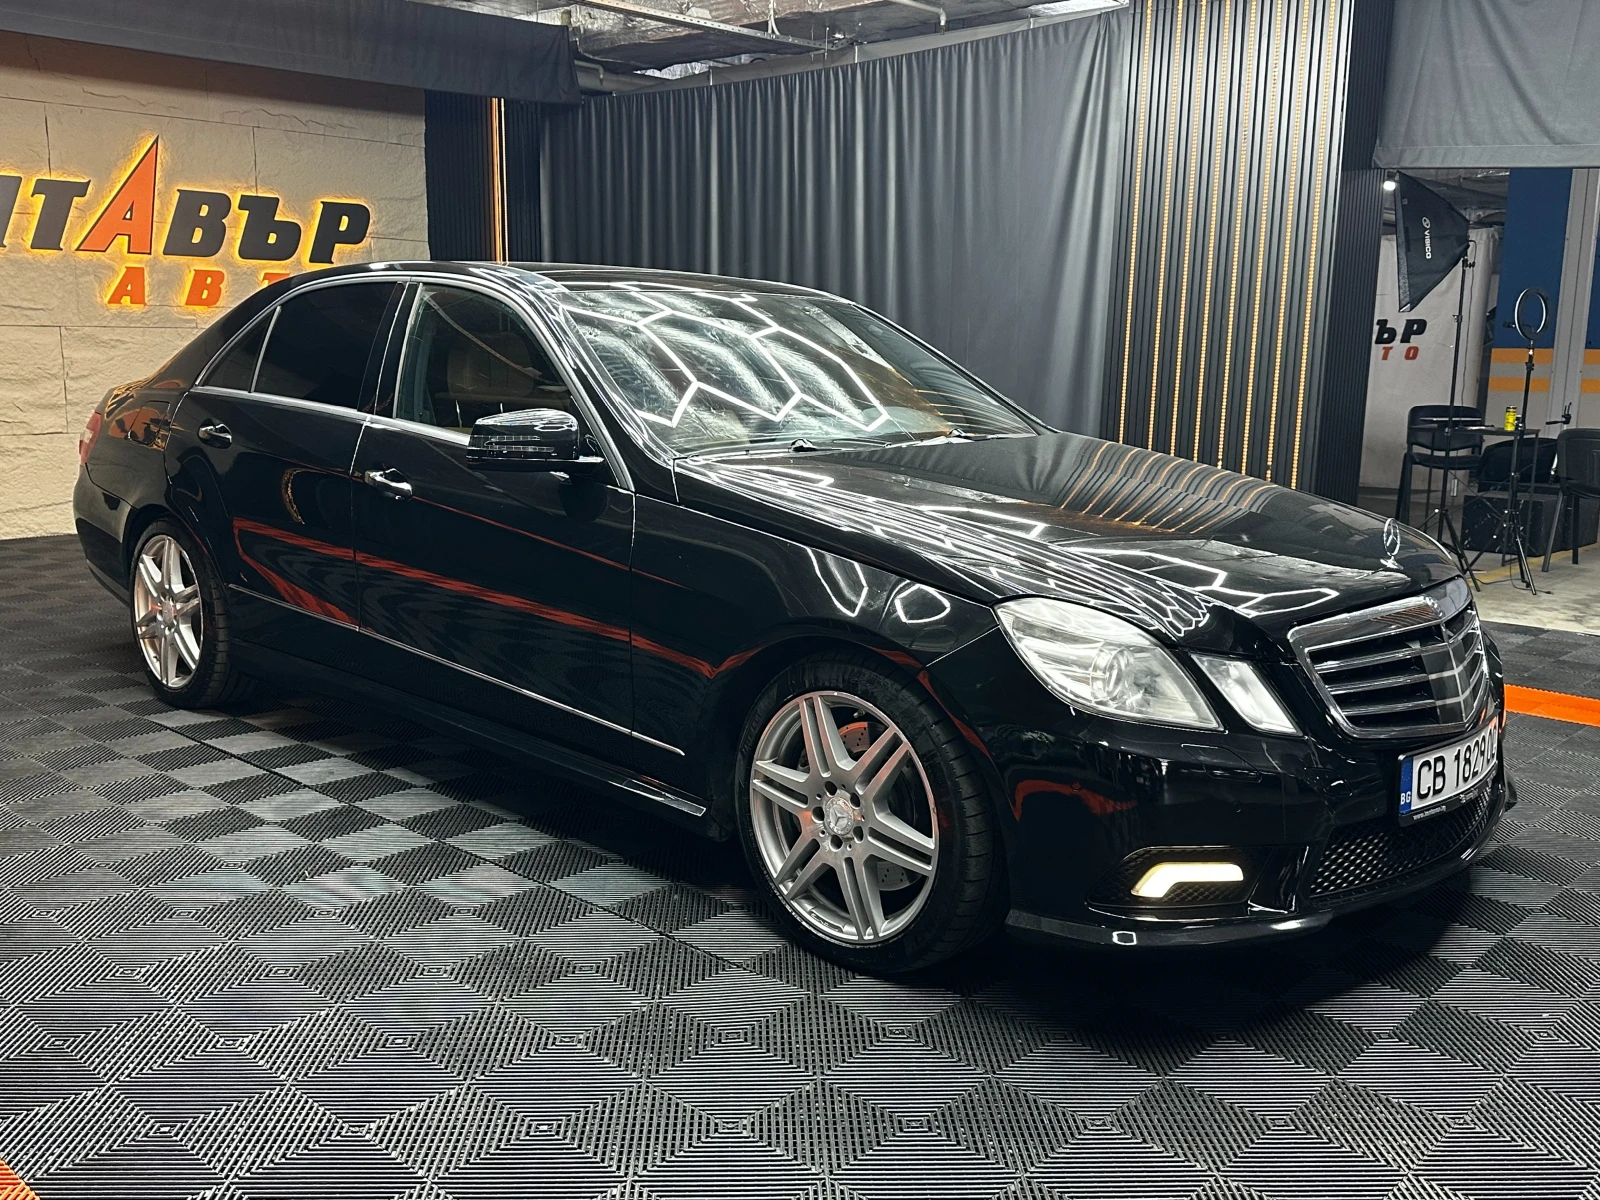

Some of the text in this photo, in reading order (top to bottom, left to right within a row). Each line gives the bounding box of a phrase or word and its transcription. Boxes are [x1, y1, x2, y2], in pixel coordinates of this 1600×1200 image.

[1417, 755, 1446, 800] CB
[1453, 732, 1487, 789] 1829
[1400, 791, 1412, 805] BG
